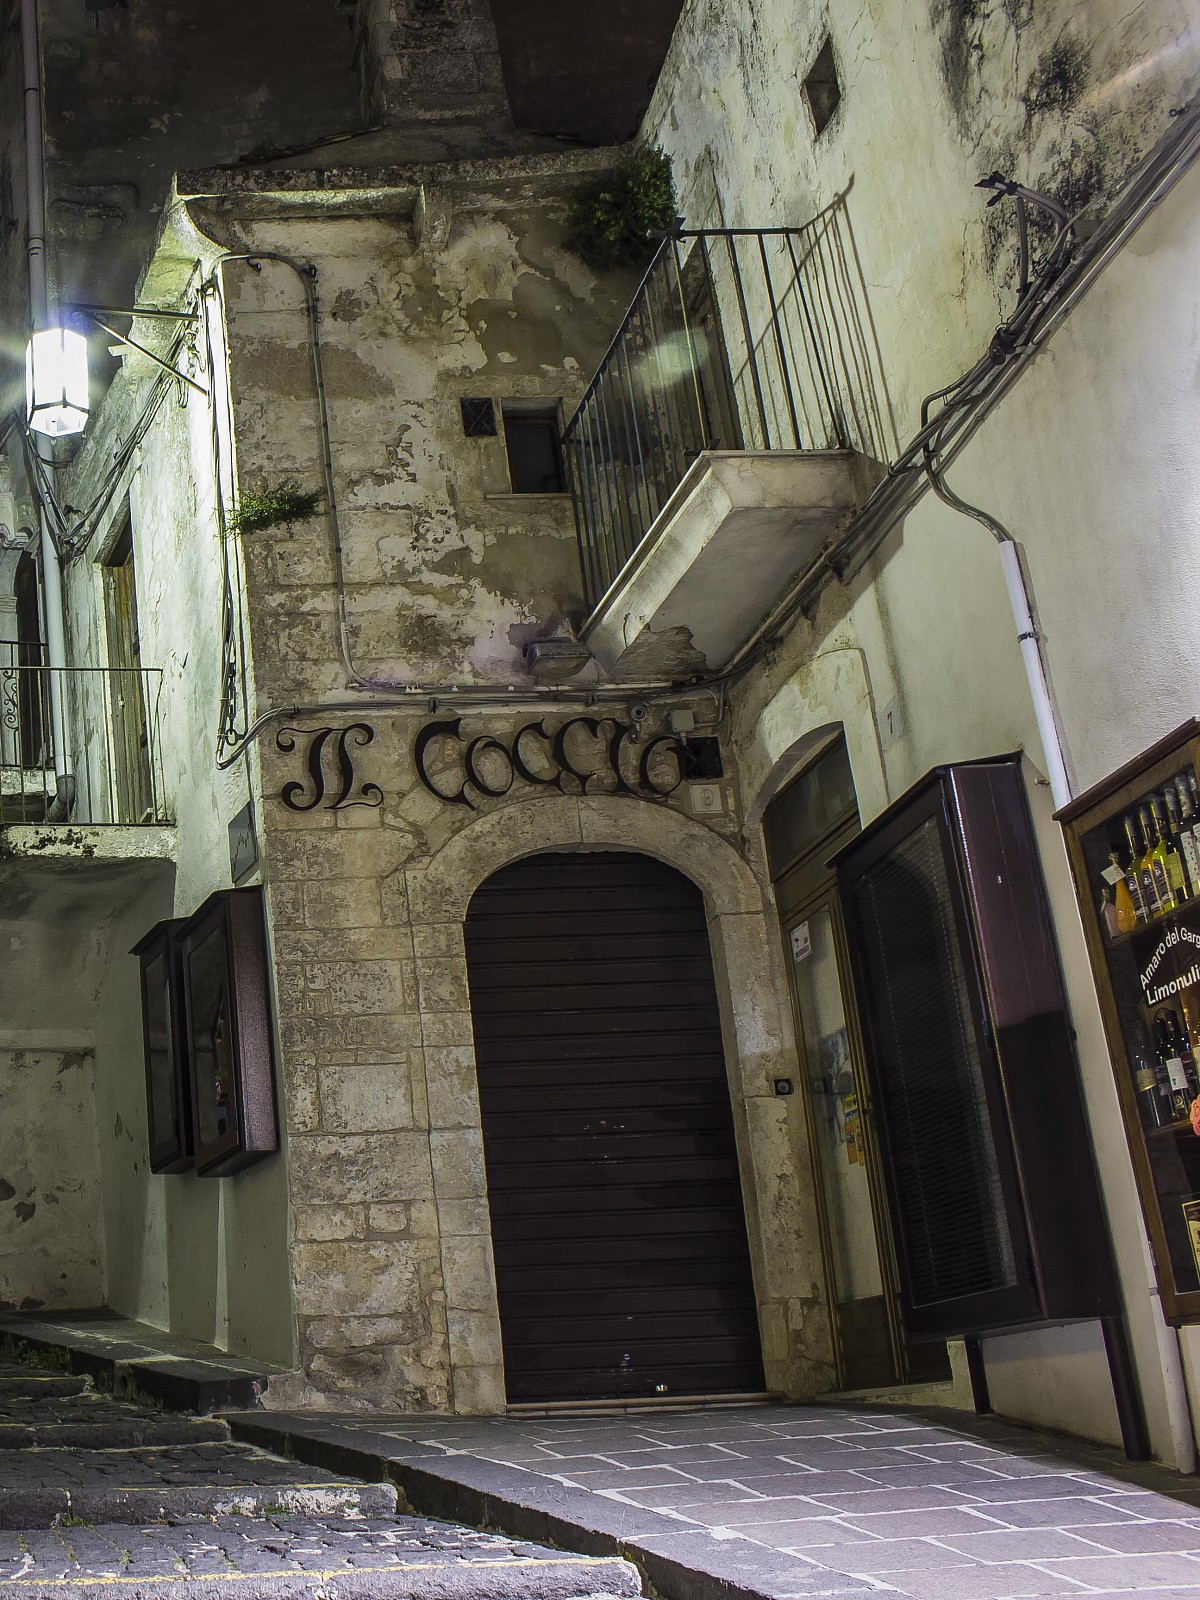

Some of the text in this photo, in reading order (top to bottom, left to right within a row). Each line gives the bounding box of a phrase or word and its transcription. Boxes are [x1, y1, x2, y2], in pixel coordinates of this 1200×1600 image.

[1140, 942, 1166, 990] Amaro
[1165, 927, 1180, 948] del
[1146, 964, 1200, 1005] Limonuli
